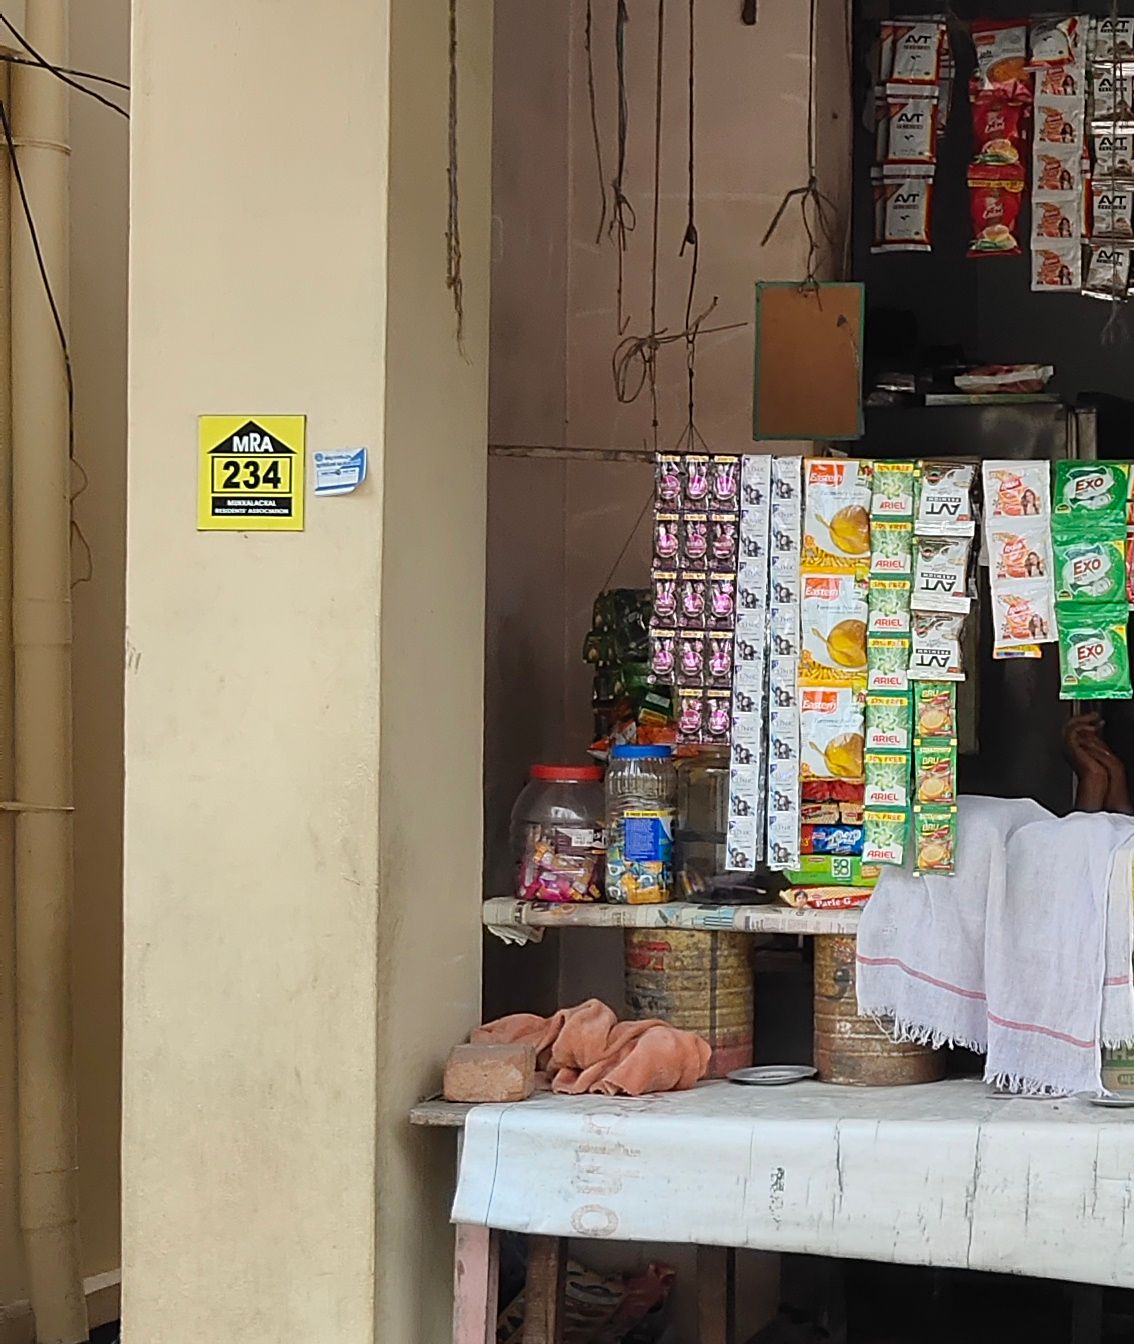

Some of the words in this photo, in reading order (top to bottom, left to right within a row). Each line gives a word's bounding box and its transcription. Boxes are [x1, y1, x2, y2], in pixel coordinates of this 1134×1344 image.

[905, 35, 931, 44] AVT
[898, 113, 924, 123] AVT
[894, 194, 920, 203] AVT
[232, 432, 274, 452] MRA
[222, 460, 281, 489] 234
[879, 501, 906, 509] ARIEL
[926, 503, 961, 515] AVT
[875, 560, 905, 568] ARIEL
[920, 579, 956, 591] AVT
[916, 655, 950, 667] AVT
[873, 677, 902, 685] ARIEL
[872, 735, 900, 743] ARIEL
[867, 850, 896, 859] ARIEL
